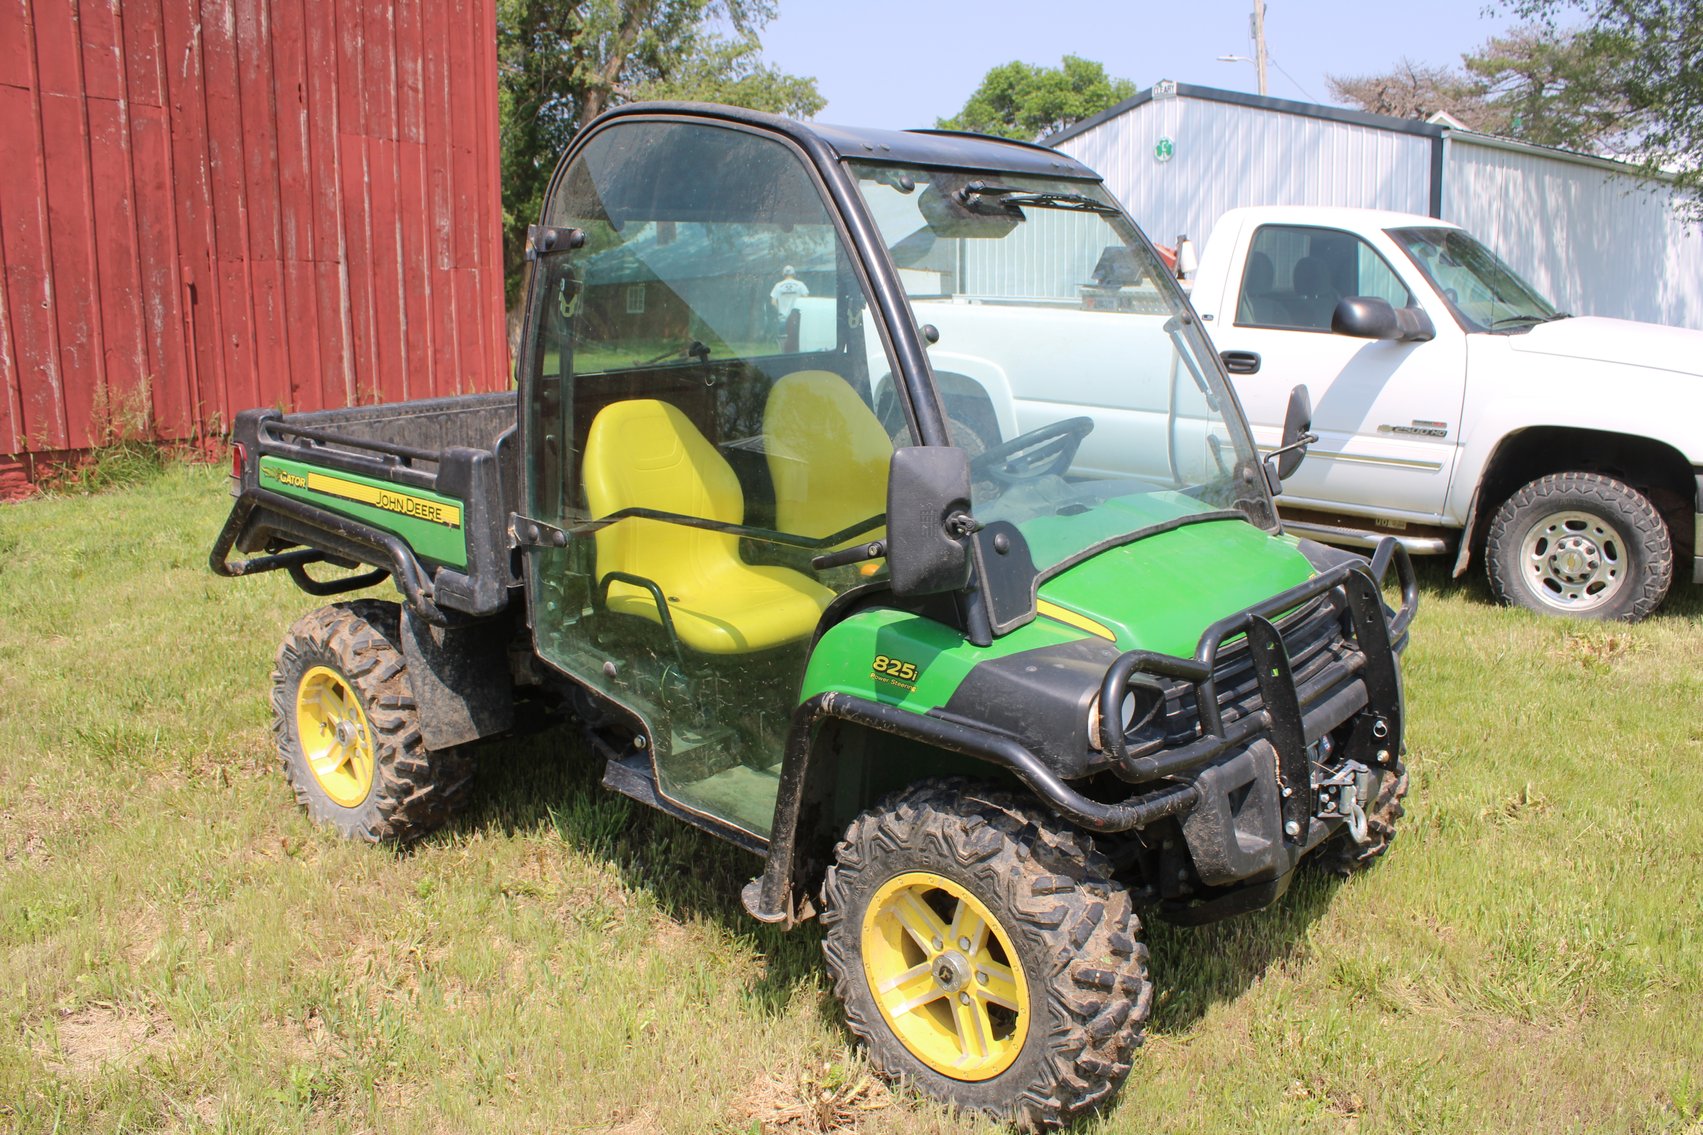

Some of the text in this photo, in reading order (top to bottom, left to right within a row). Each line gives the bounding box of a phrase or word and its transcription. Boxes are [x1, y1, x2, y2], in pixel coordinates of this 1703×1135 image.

[375, 491, 443, 522] JOHN DEERE
[872, 655, 918, 682] 825i
